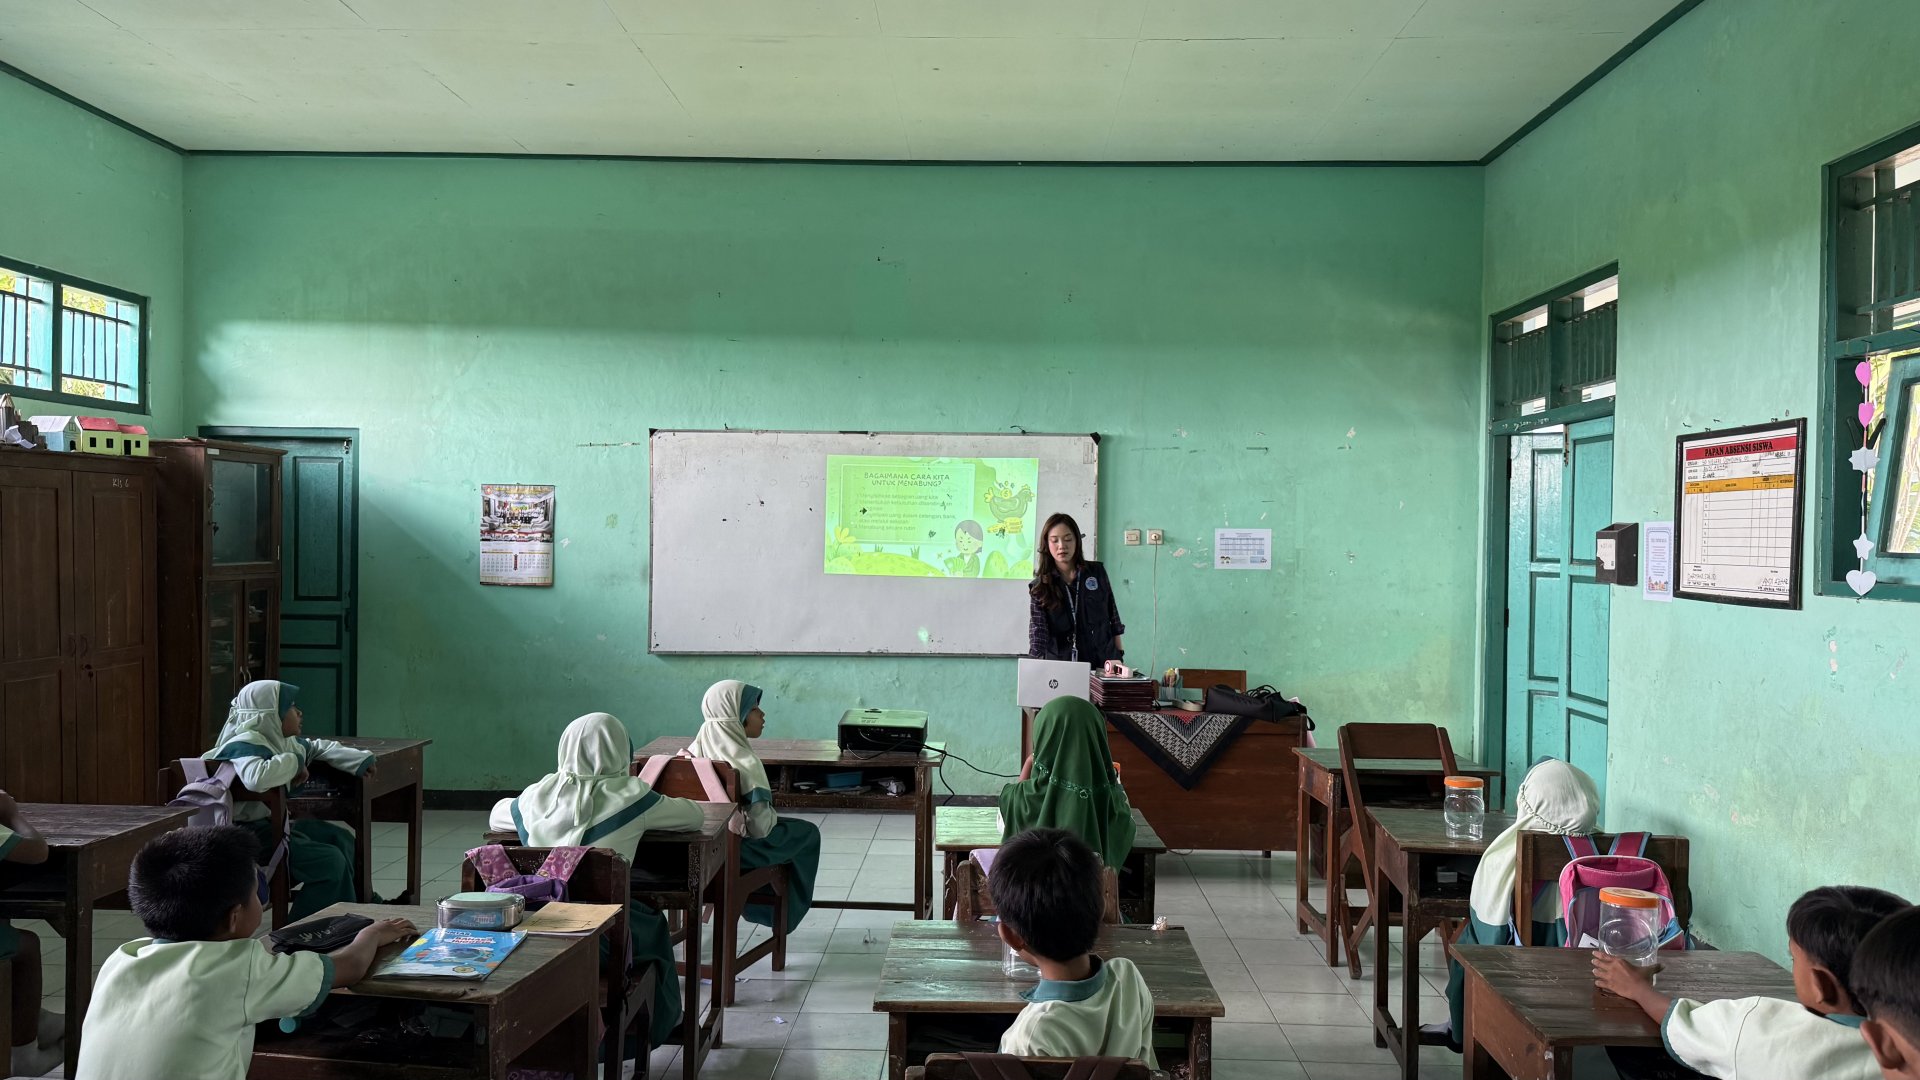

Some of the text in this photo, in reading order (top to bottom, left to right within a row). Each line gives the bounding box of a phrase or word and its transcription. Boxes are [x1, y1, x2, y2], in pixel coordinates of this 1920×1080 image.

[1704, 442, 1773, 457] PAPAN ABSENSI SISWA
[864, 472, 909, 480] BAGAIMANA
[1049, 679, 1059, 690] hp
